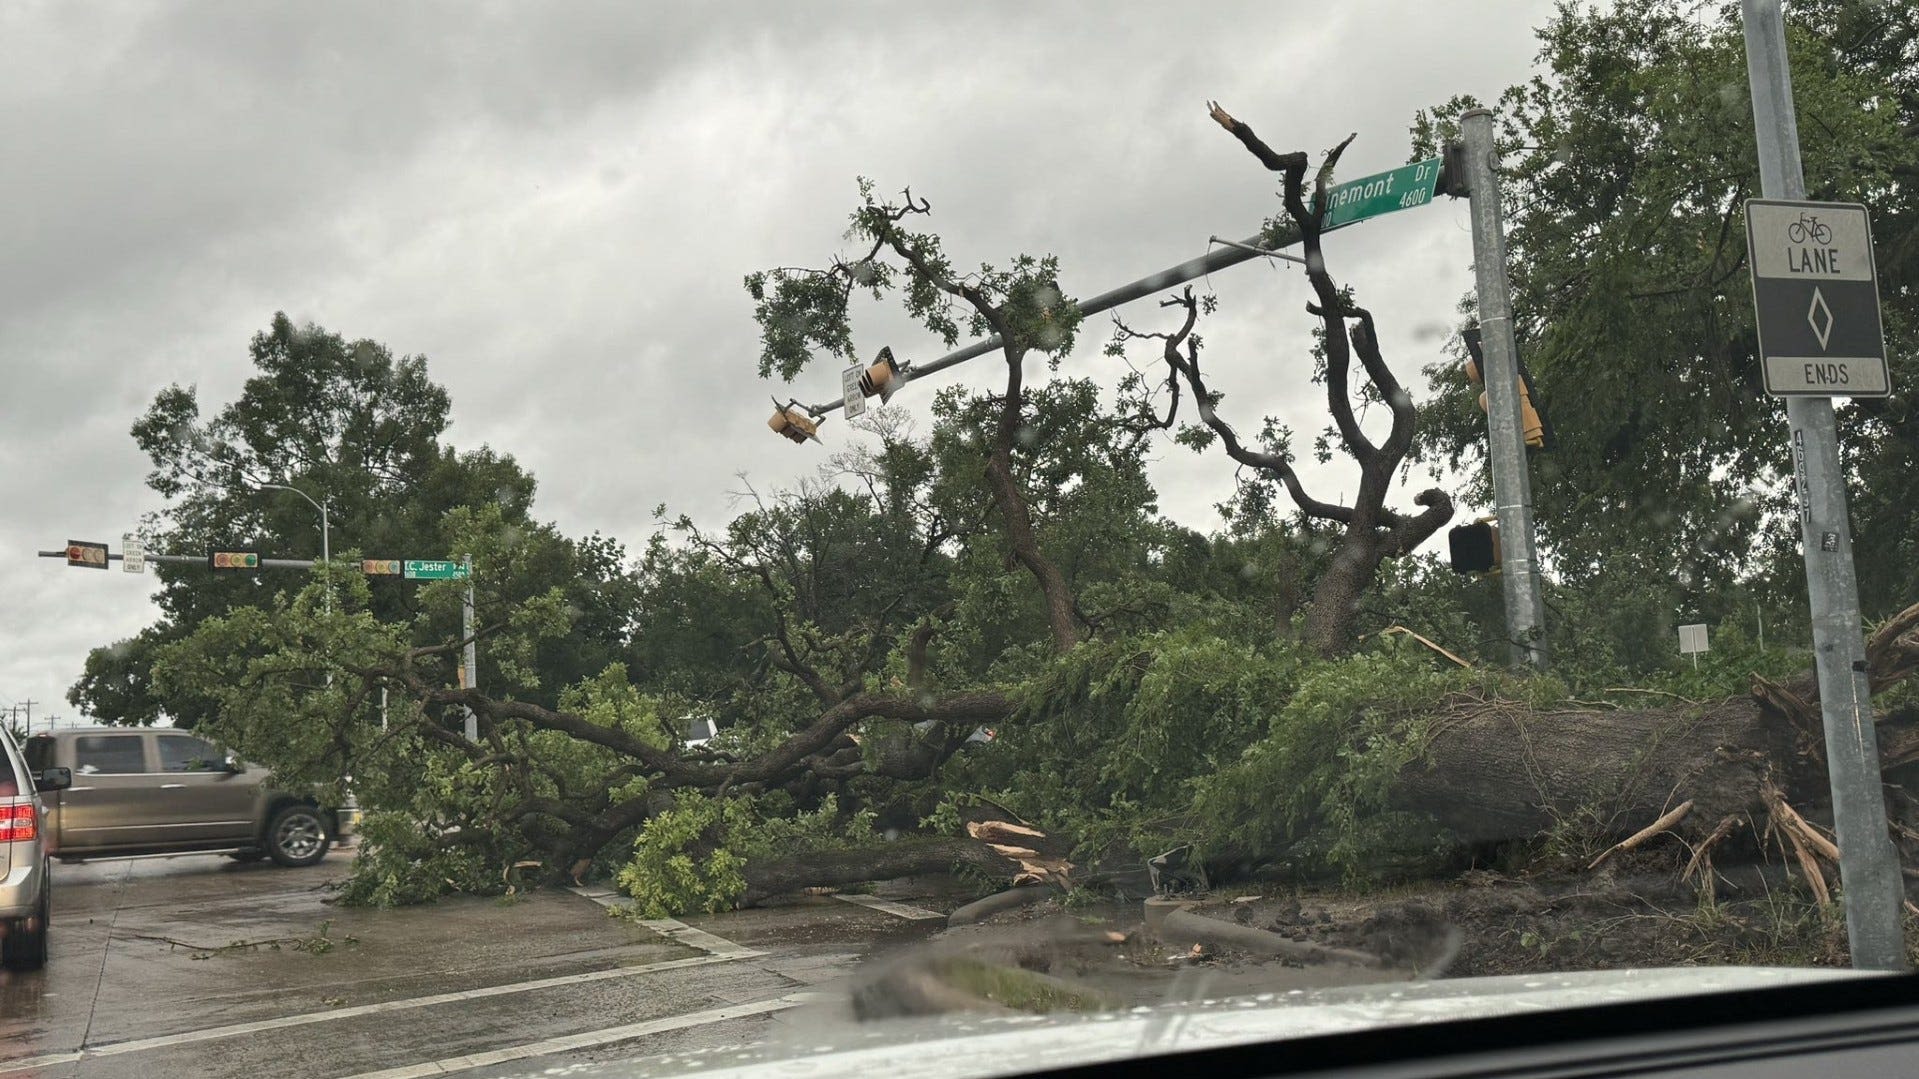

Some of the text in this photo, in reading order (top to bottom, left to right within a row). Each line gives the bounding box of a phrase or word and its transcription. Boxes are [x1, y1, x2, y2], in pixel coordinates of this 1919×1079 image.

[1324, 164, 1431, 210] inemont Dr
[1399, 187, 1426, 208] 4600
[1788, 247, 1840, 274] LANE
[1804, 364, 1849, 384] ENDS
[419, 562, 446, 571] Jester
